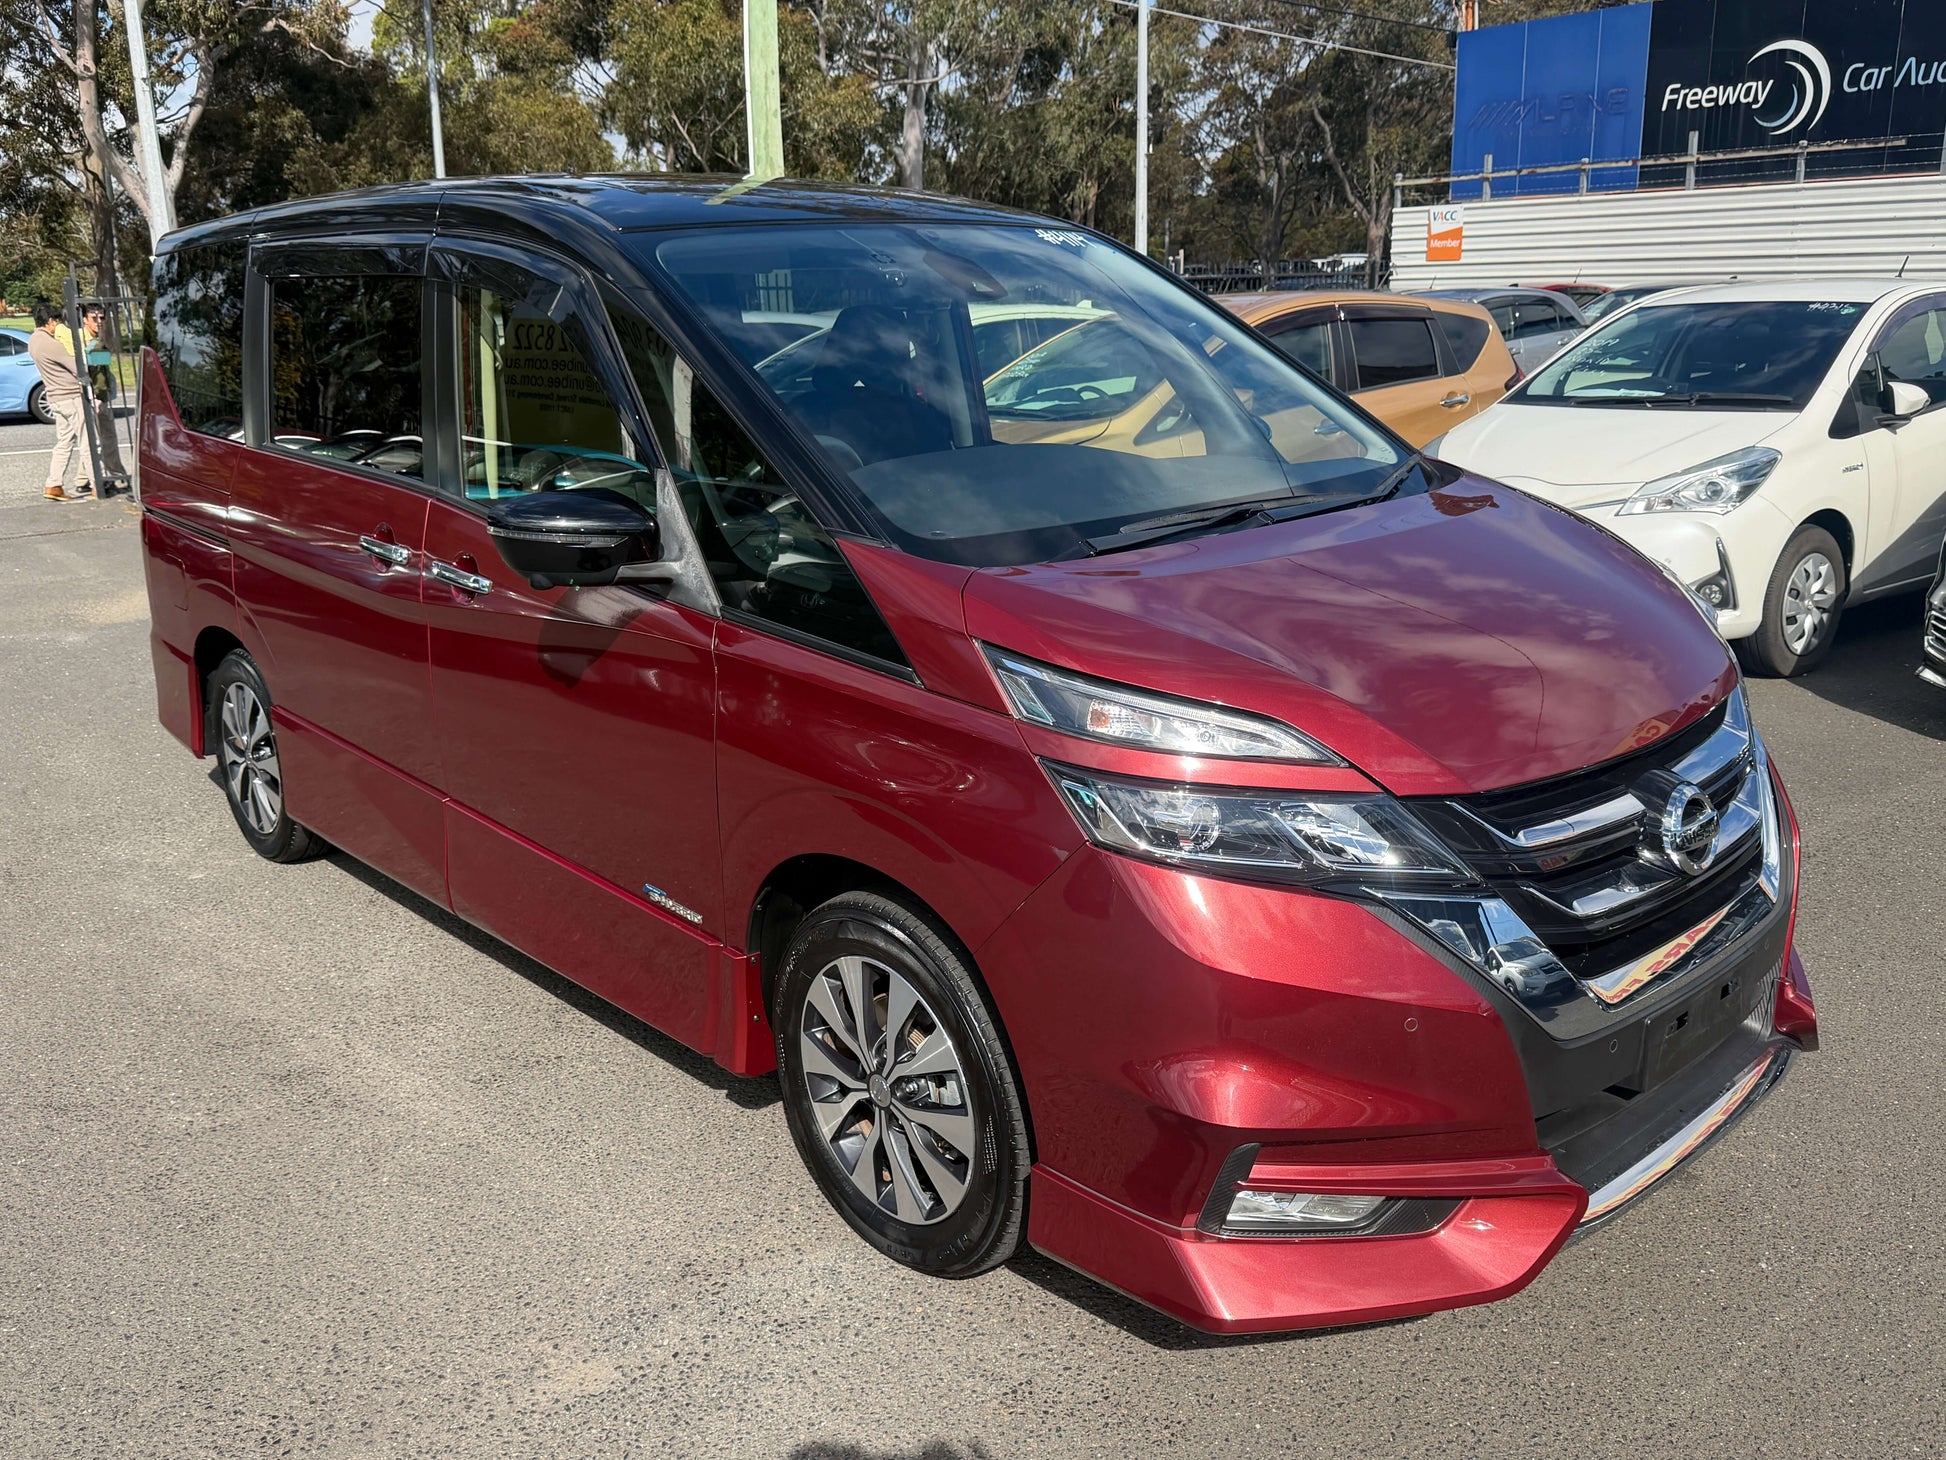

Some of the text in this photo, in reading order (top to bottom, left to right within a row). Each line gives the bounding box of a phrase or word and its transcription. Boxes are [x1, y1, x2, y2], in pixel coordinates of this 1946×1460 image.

[1661, 79, 1774, 112] Freeway
[1842, 62, 1893, 93] Car
[1432, 210, 1458, 222] VACC
[1430, 238, 1461, 248] Member
